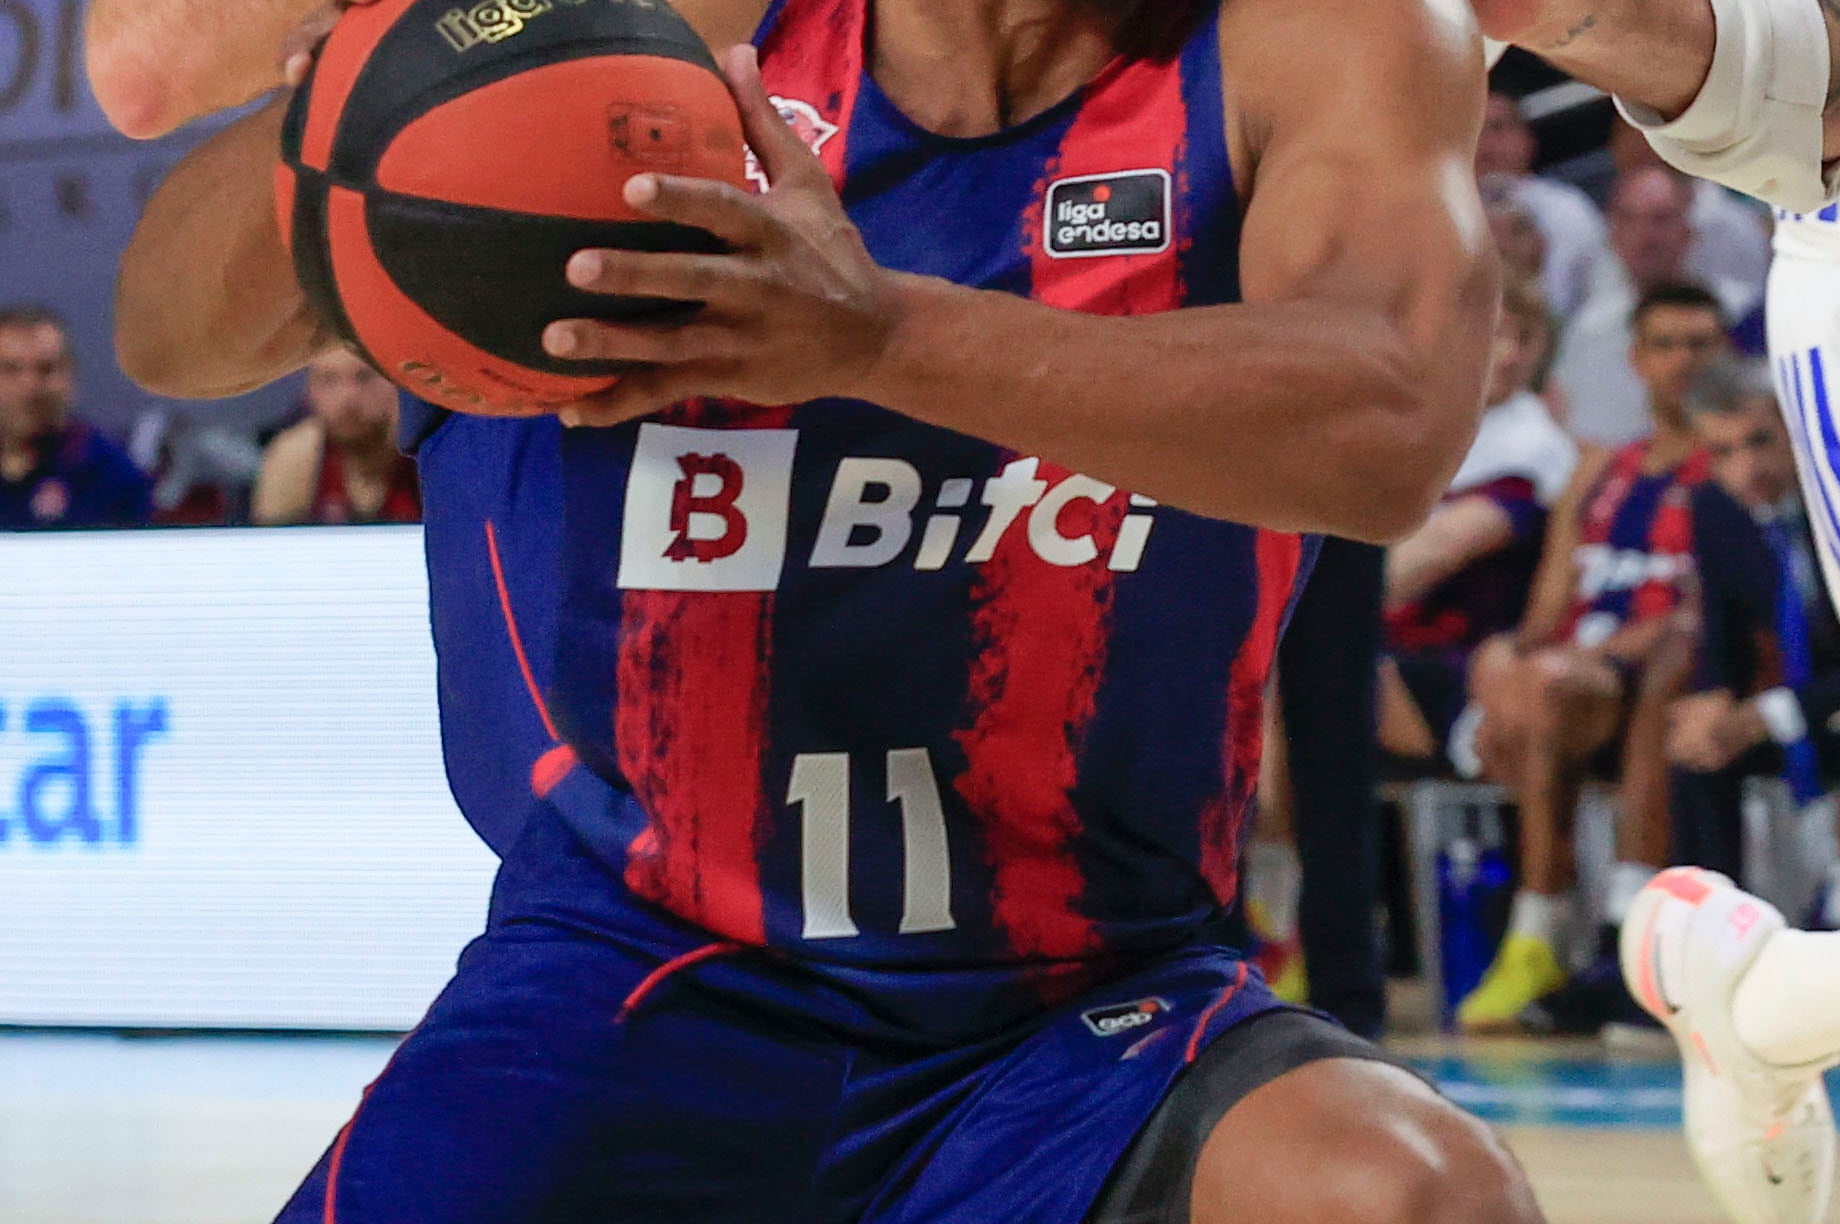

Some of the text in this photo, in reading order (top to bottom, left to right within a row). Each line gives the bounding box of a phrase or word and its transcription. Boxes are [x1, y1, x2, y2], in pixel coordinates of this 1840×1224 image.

[1057, 199, 1105, 225] liga
[1057, 219, 1161, 245] endesa
[807, 456, 1158, 573] Bitci
[0, 696, 169, 847] ar
[786, 747, 957, 940] 11
